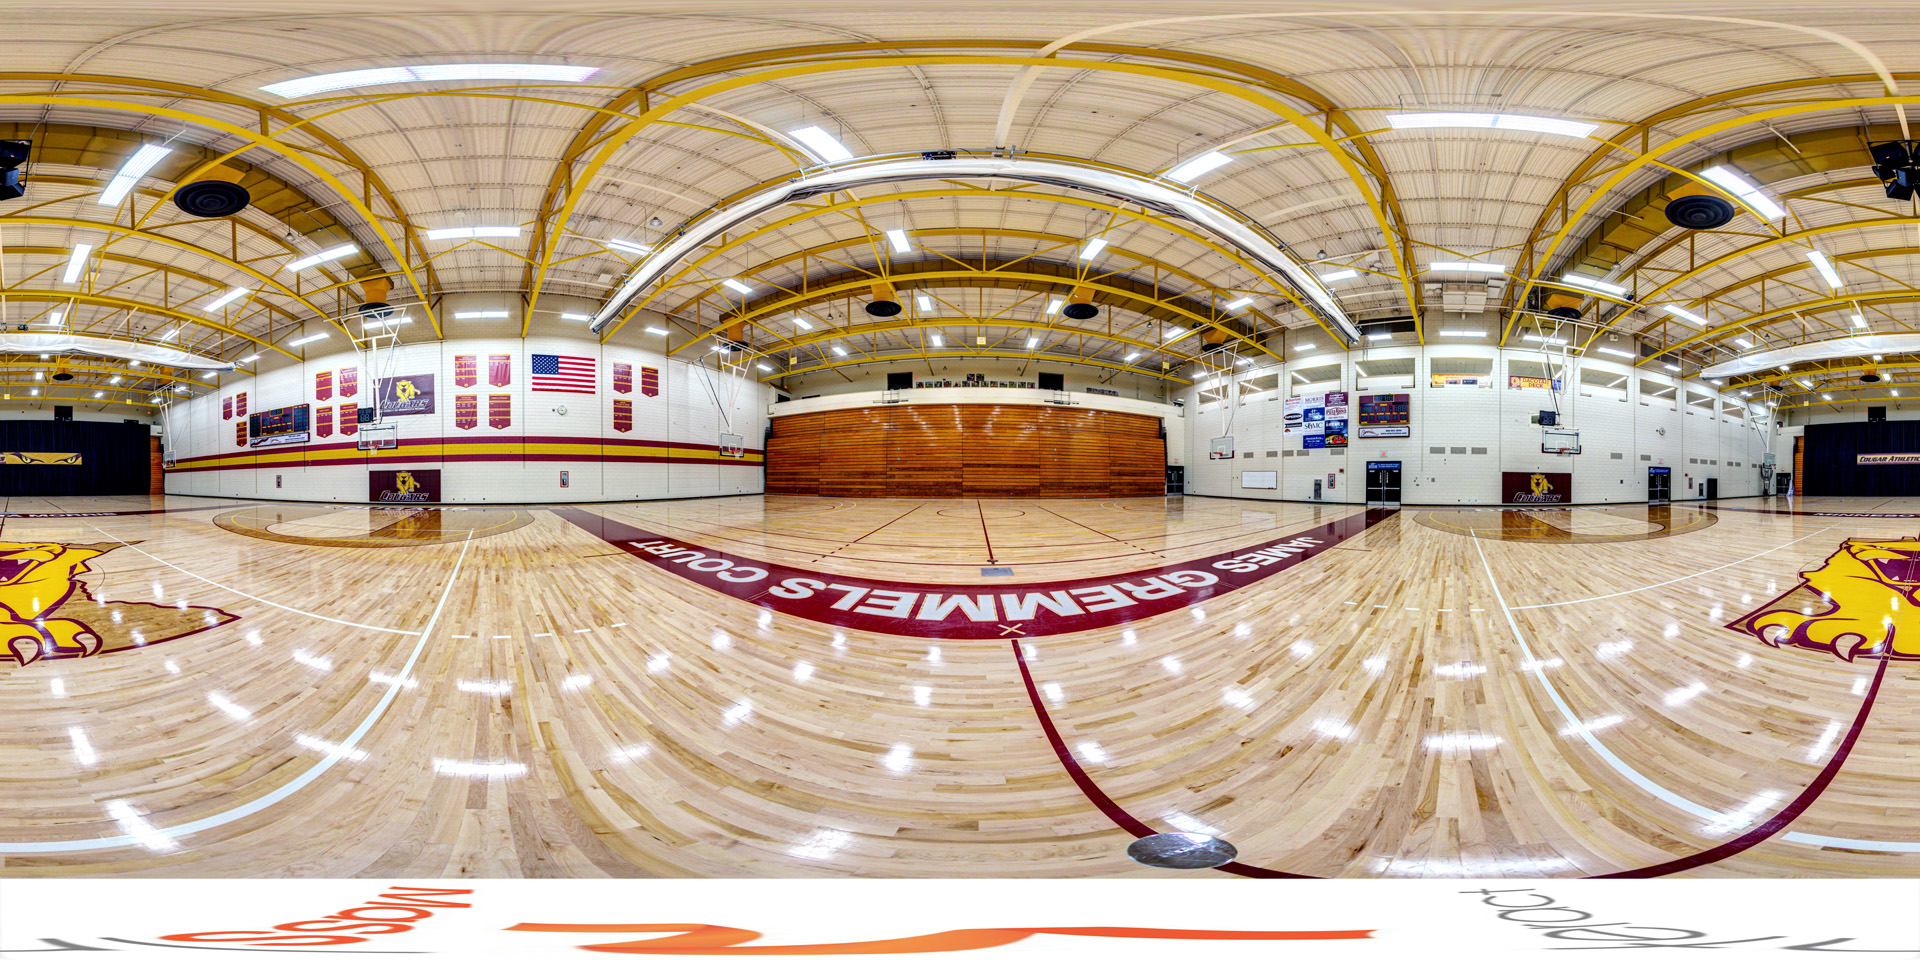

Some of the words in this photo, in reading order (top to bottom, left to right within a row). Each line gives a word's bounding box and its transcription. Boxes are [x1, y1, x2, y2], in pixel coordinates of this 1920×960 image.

[380, 399, 429, 410] COUGARS
[379, 490, 429, 502] COUGARS
[1513, 492, 1561, 502] COUGARS
[628, 540, 769, 583] COURT
[1212, 537, 1324, 573] JAMES
[769, 570, 1219, 622] GREMMELS
